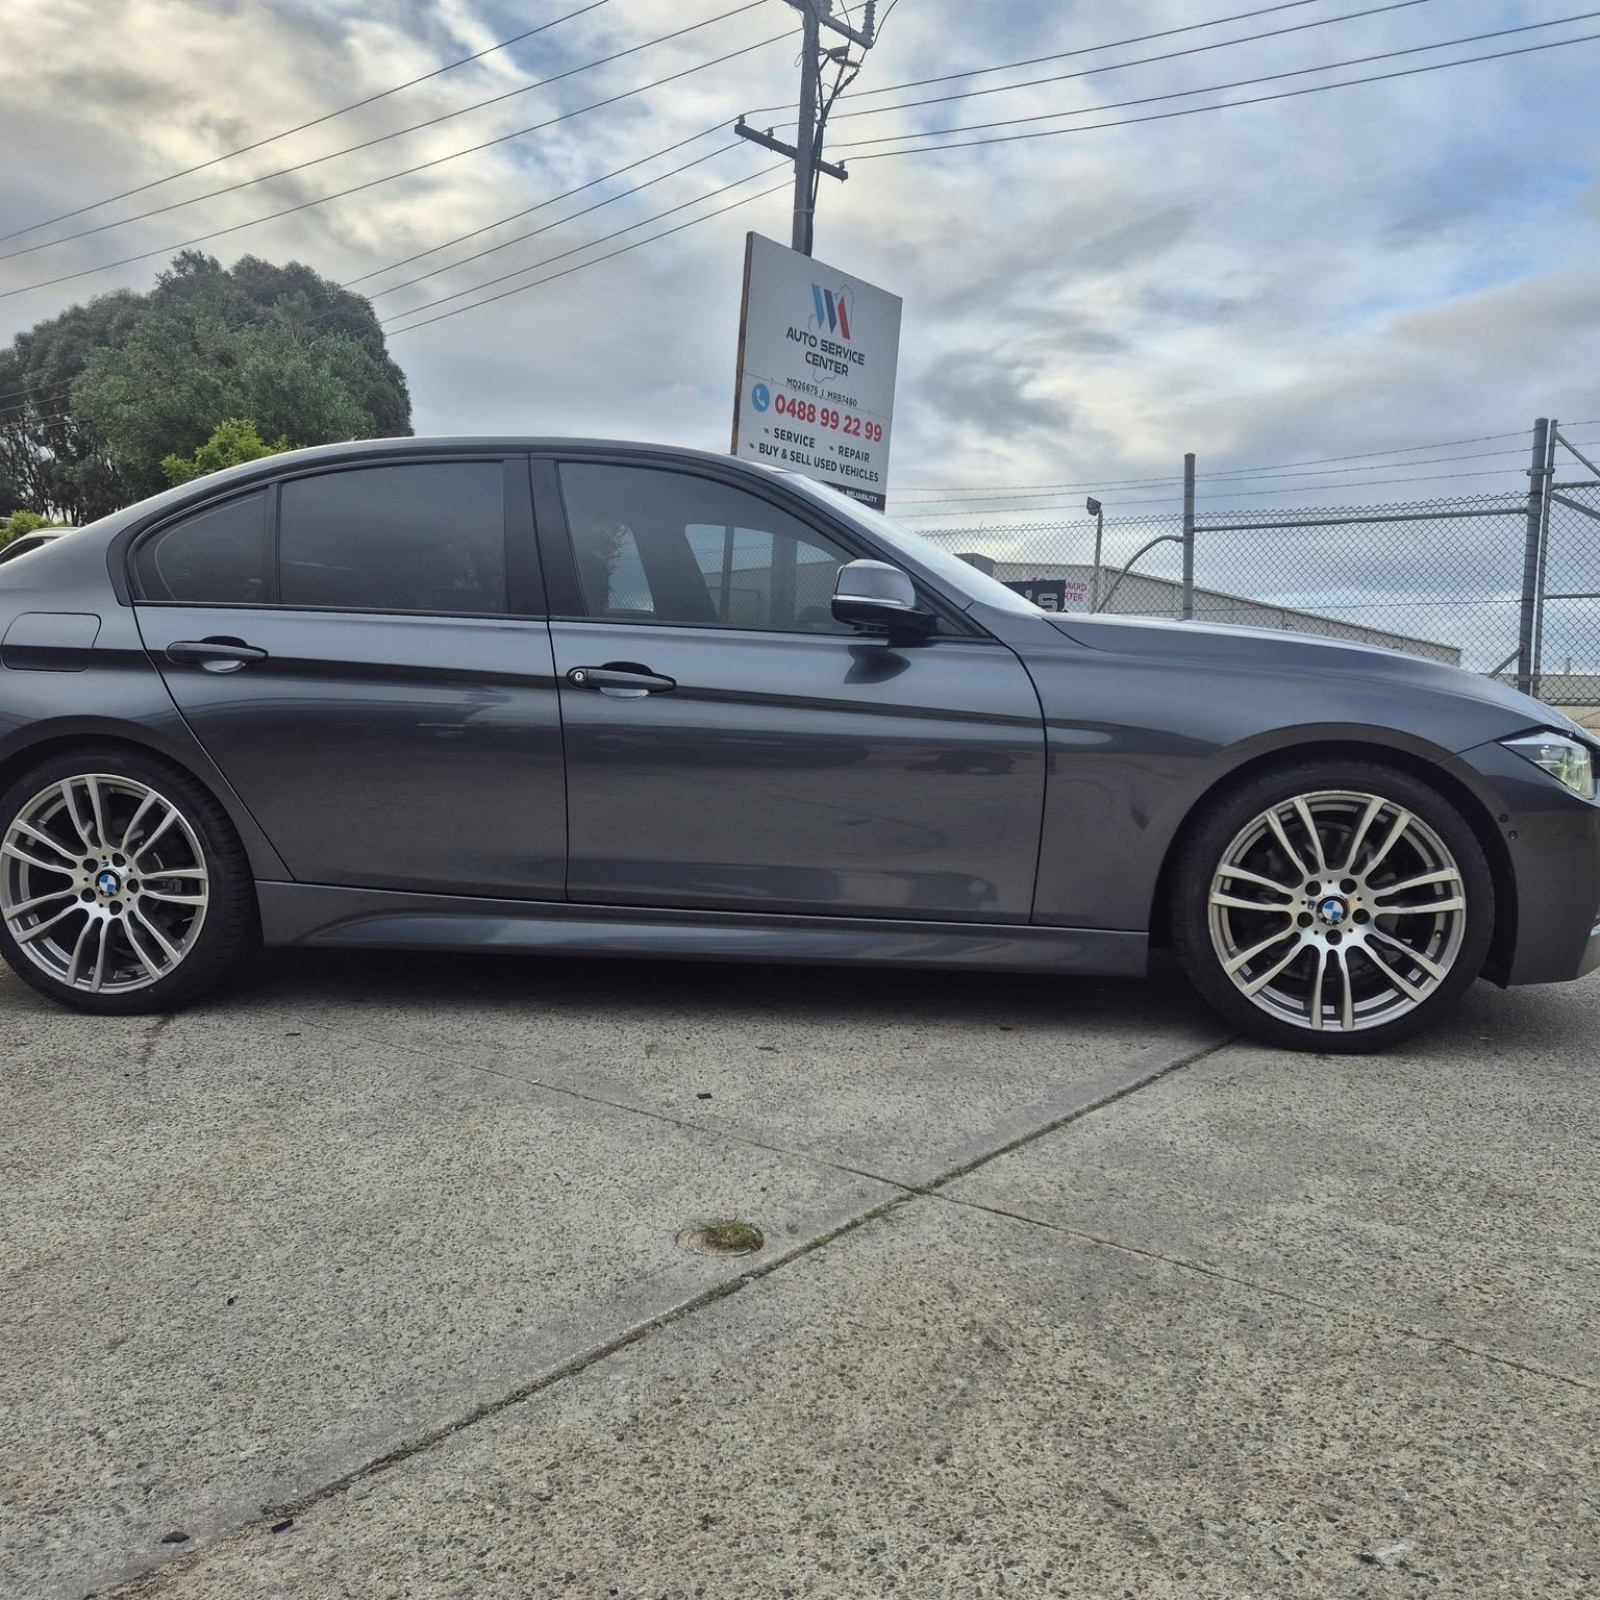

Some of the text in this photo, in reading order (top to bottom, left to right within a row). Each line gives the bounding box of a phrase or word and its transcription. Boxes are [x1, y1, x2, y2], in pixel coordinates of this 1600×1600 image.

[786, 326, 866, 366] AUTO SERVICE
[805, 351, 849, 377] CENTER
[786, 377, 819, 395] MD26675
[774, 393, 882, 443] 0488 99 22 99
[759, 442, 879, 483] BUY & SELL USED VEHICLES
[773, 427, 870, 463] SERVICE REPAIR
